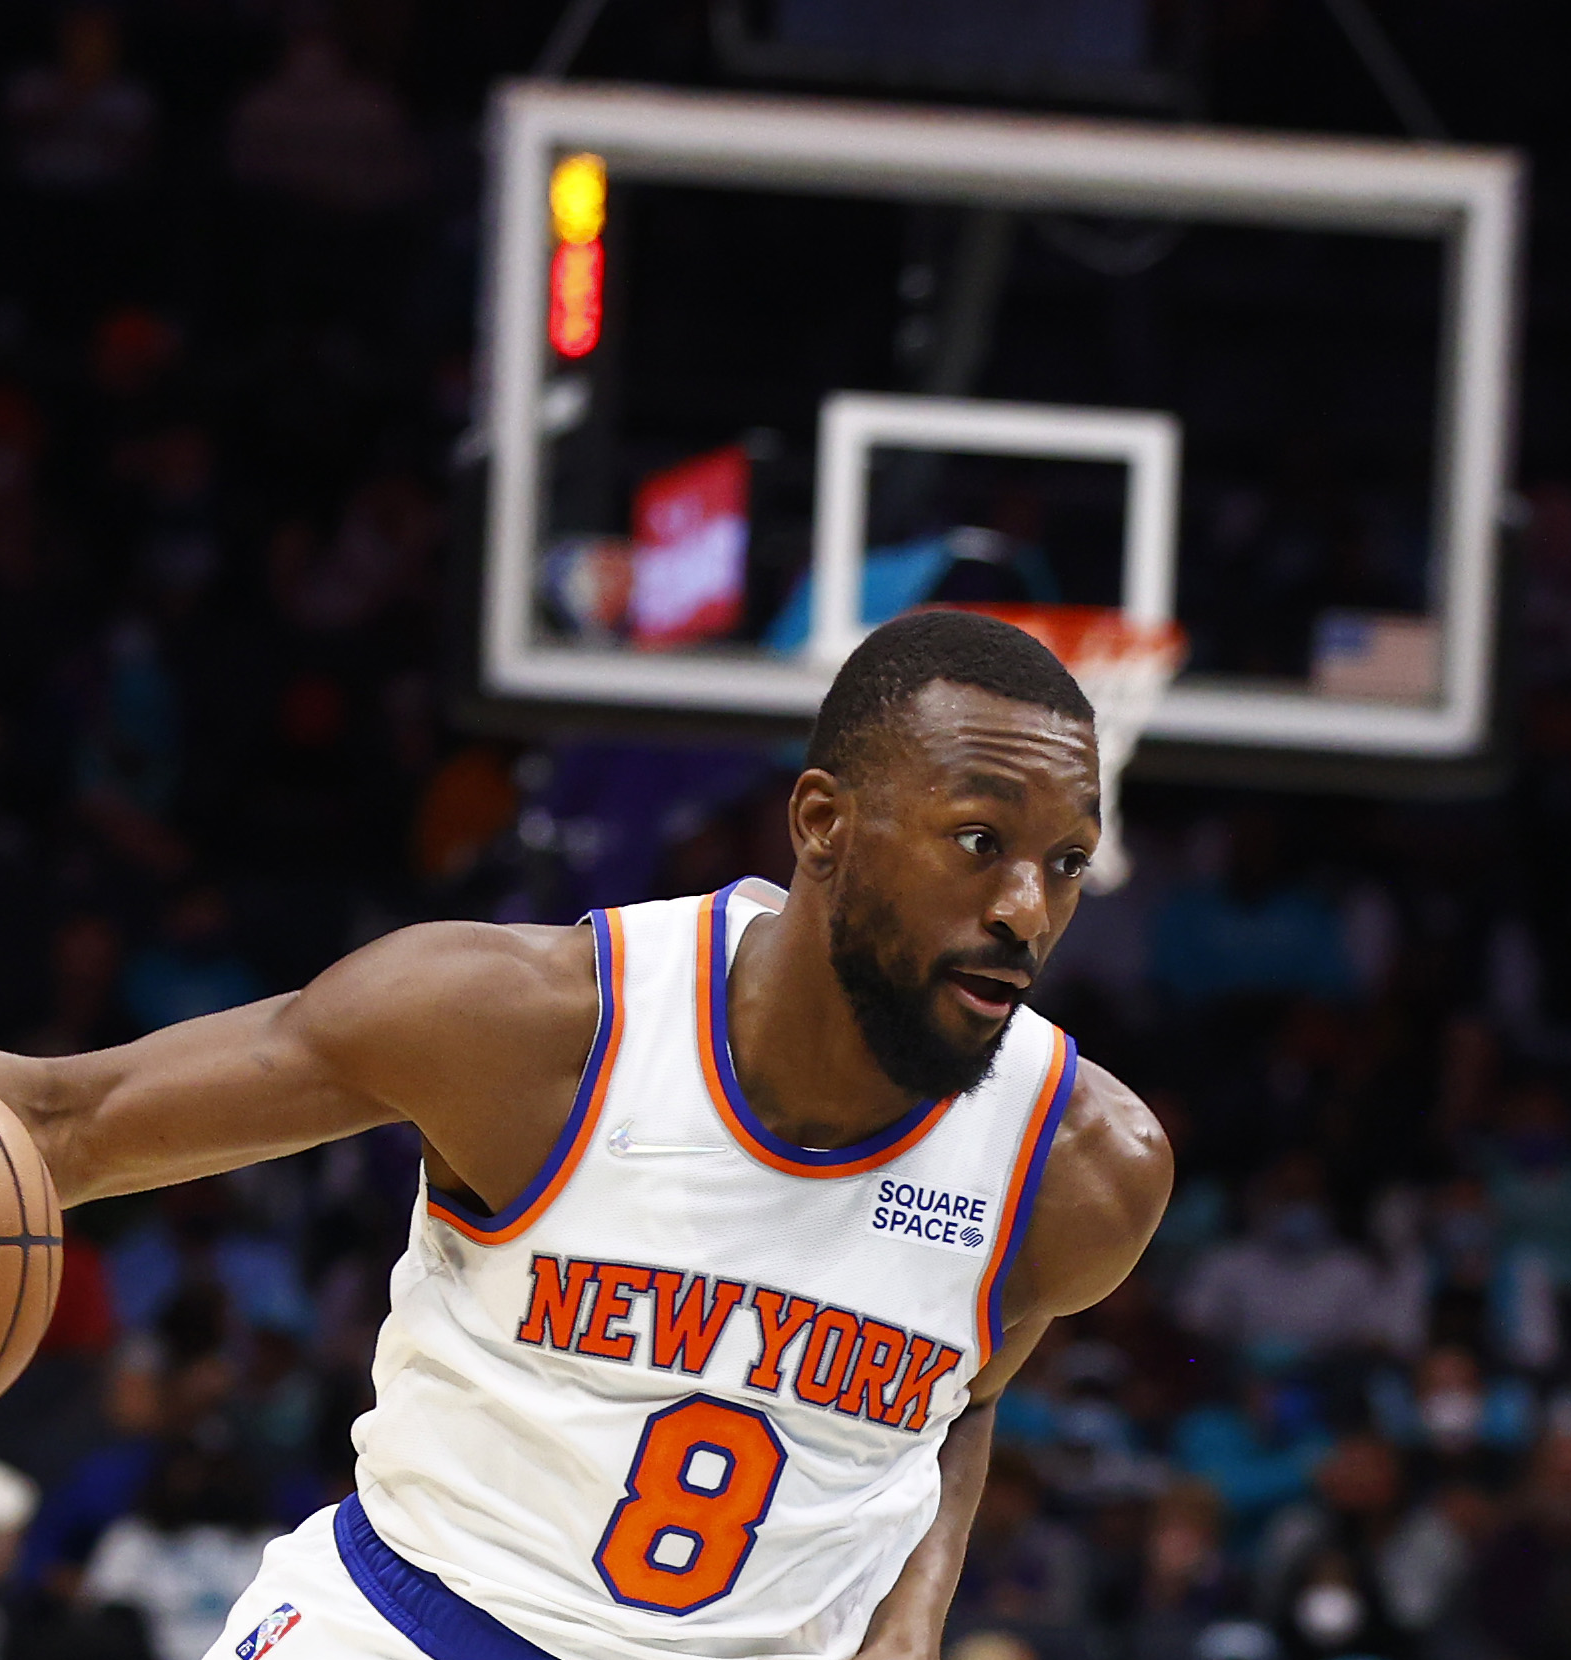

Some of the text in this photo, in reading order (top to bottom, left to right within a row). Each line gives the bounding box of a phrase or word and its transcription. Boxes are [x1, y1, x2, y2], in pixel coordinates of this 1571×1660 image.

[872, 1207, 959, 1244] SPACE
[878, 1180, 987, 1222] SQUARE
[515, 1255, 963, 1435] NEW YORK
[592, 1392, 788, 1616] 8
